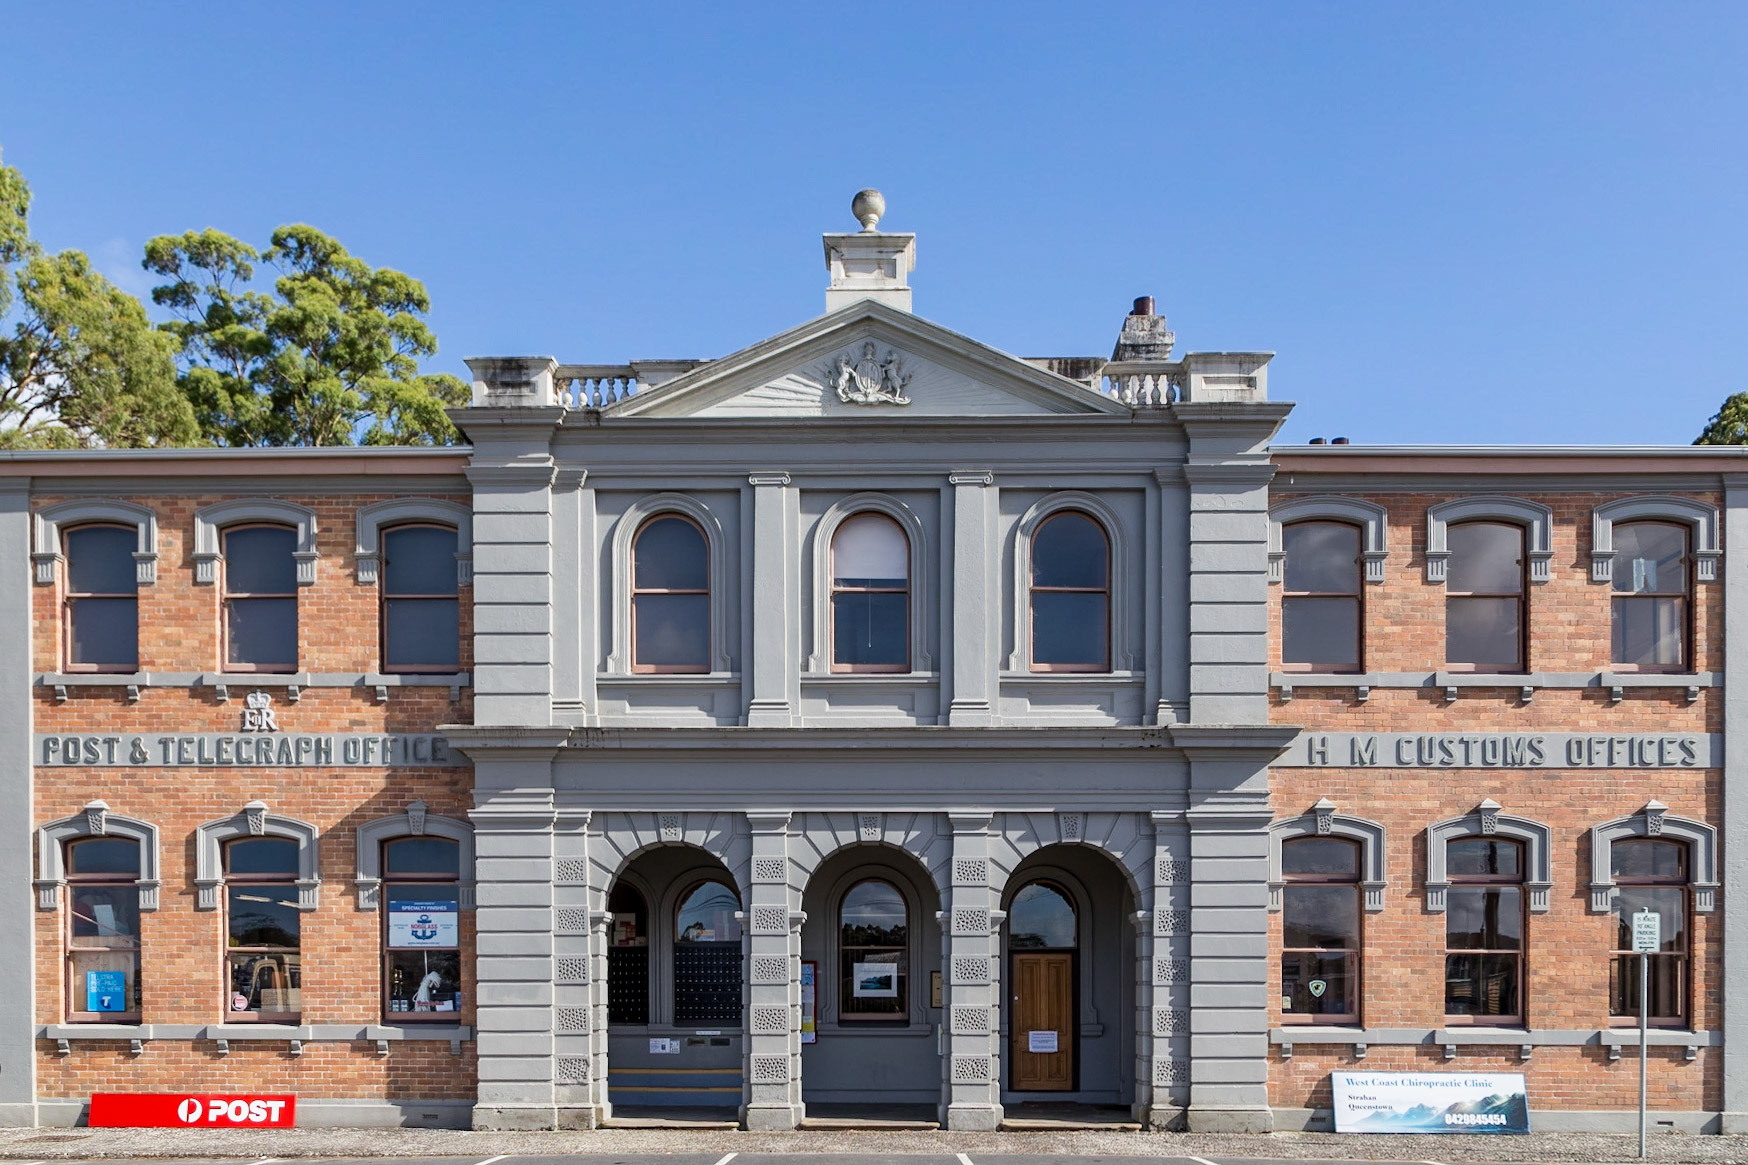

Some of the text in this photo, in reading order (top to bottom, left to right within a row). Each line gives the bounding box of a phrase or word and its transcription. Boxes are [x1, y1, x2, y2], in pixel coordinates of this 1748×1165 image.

[42, 736, 449, 766] POST & TELEGRAPH OFFICE
[1308, 735, 1698, 767] H M CUSTOMS OFFICES
[1346, 1078, 1493, 1088] West Coast Chiropractic Clinic
[208, 1100, 286, 1122] POST
[1348, 1103, 1393, 1112] Queenstown
[1445, 1114, 1507, 1126] 0429845454
